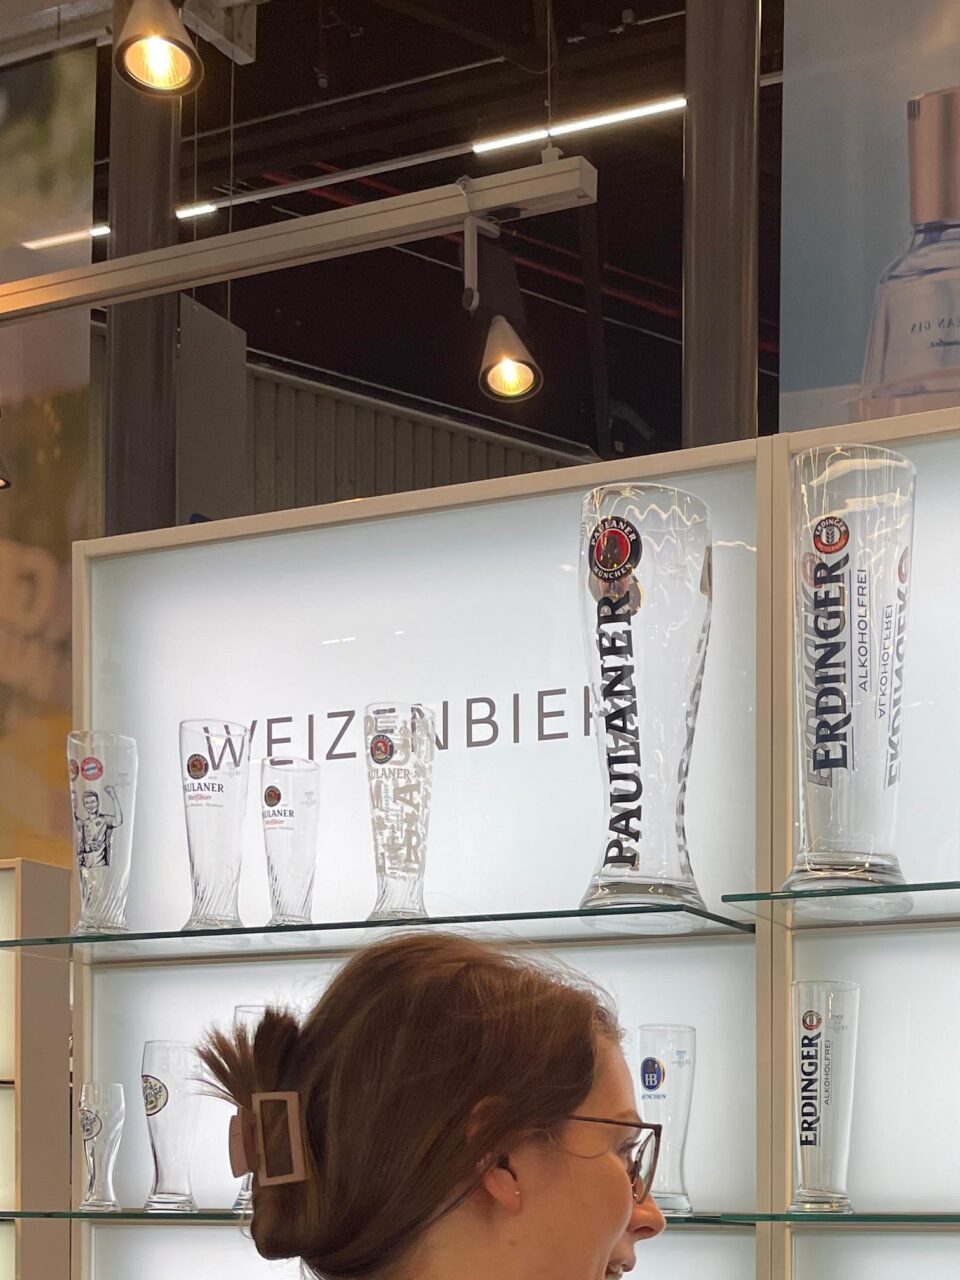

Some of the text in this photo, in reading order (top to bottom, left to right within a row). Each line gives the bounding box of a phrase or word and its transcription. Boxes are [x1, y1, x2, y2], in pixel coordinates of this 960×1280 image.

[591, 520, 637, 546] PAULANER
[593, 563, 632, 579] MÜNCHEN
[812, 553, 850, 771] ERDINGER
[857, 569, 869, 692] ALKOHOLFREI
[183, 782, 224, 793] AULANER
[596, 590, 643, 871] PAULANER
[800, 1031, 821, 1147] ERDINGER
